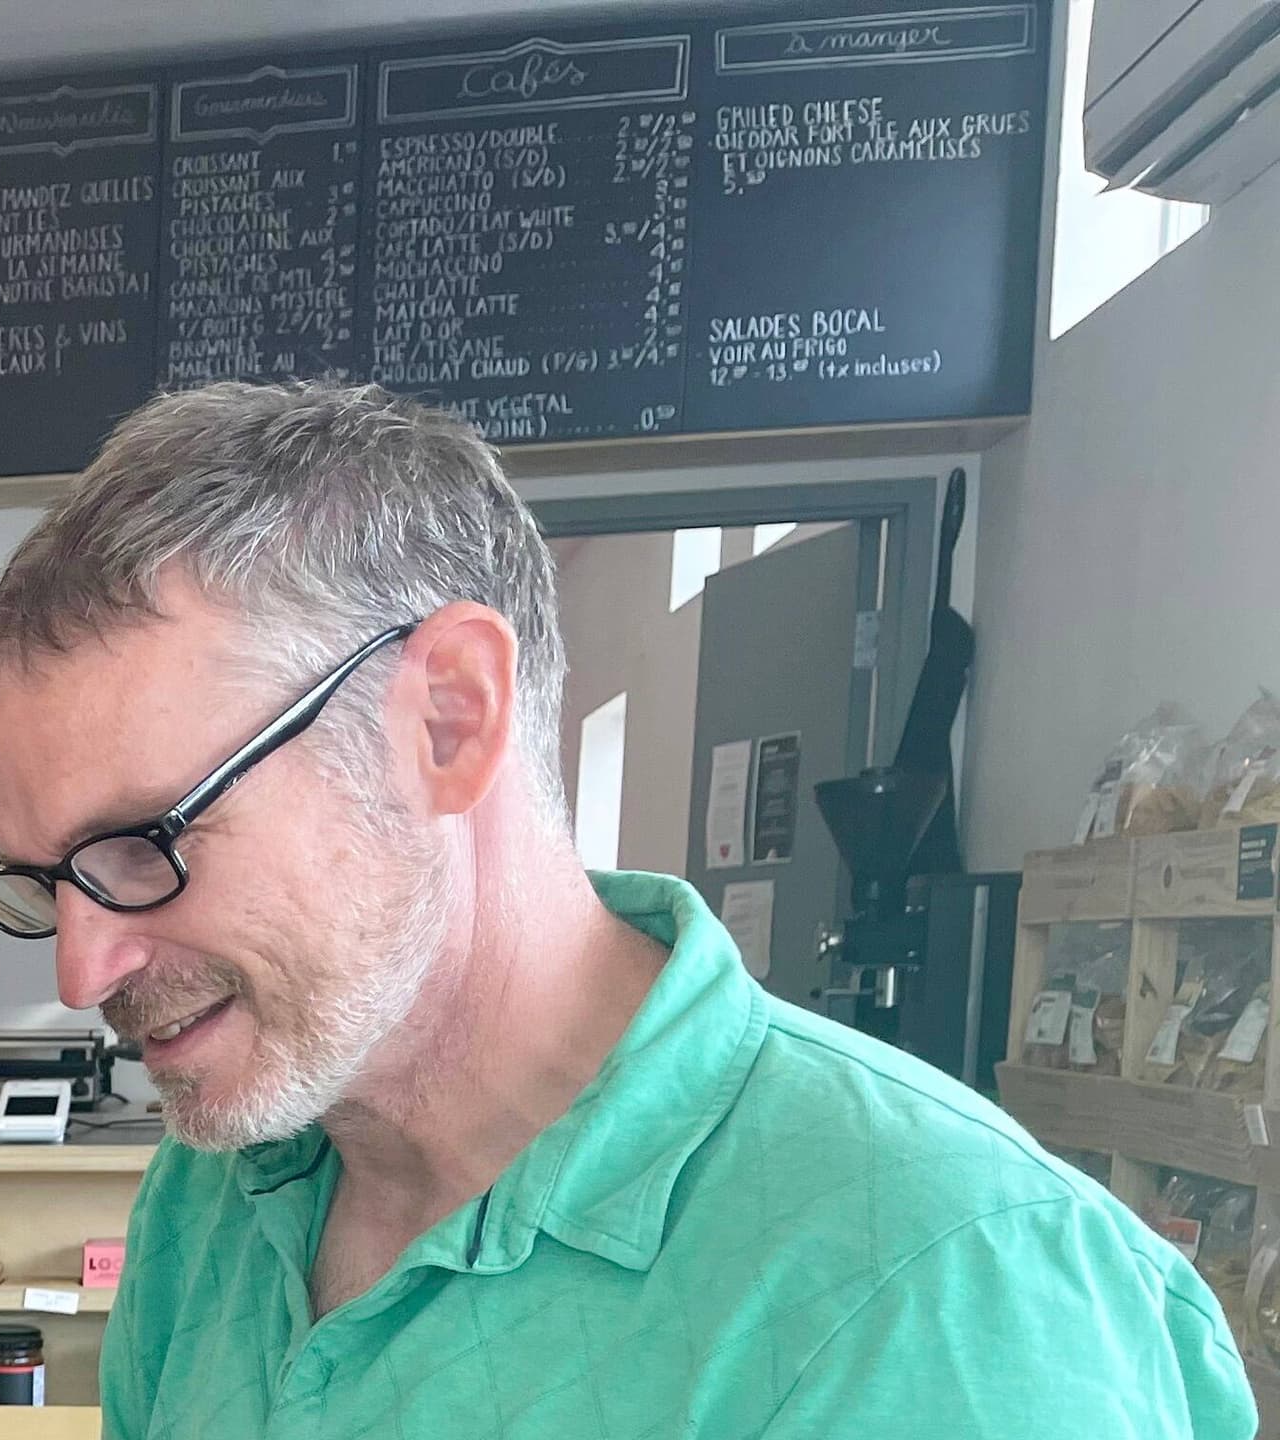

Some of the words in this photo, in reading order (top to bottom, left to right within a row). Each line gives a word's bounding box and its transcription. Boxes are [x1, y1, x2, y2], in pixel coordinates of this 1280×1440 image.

[717, 103, 794, 132] GRILLED
[804, 98, 883, 127] CHEESE
[808, 121, 854, 145] FORT
[908, 117, 951, 139] AUX
[962, 110, 1030, 136] GRUES
[723, 152, 746, 173] ET
[755, 144, 842, 170] OIGNONS
[519, 205, 575, 228] WHITE
[465, 293, 519, 317] LATTE
[79, 319, 128, 345] VINS
[709, 313, 800, 343] SALADES
[813, 307, 886, 337] BOCAL
[709, 342, 756, 366] VOIR
[761, 341, 785, 361] AU
[793, 337, 848, 359] FRIGO
[471, 357, 531, 380] CHAUD
